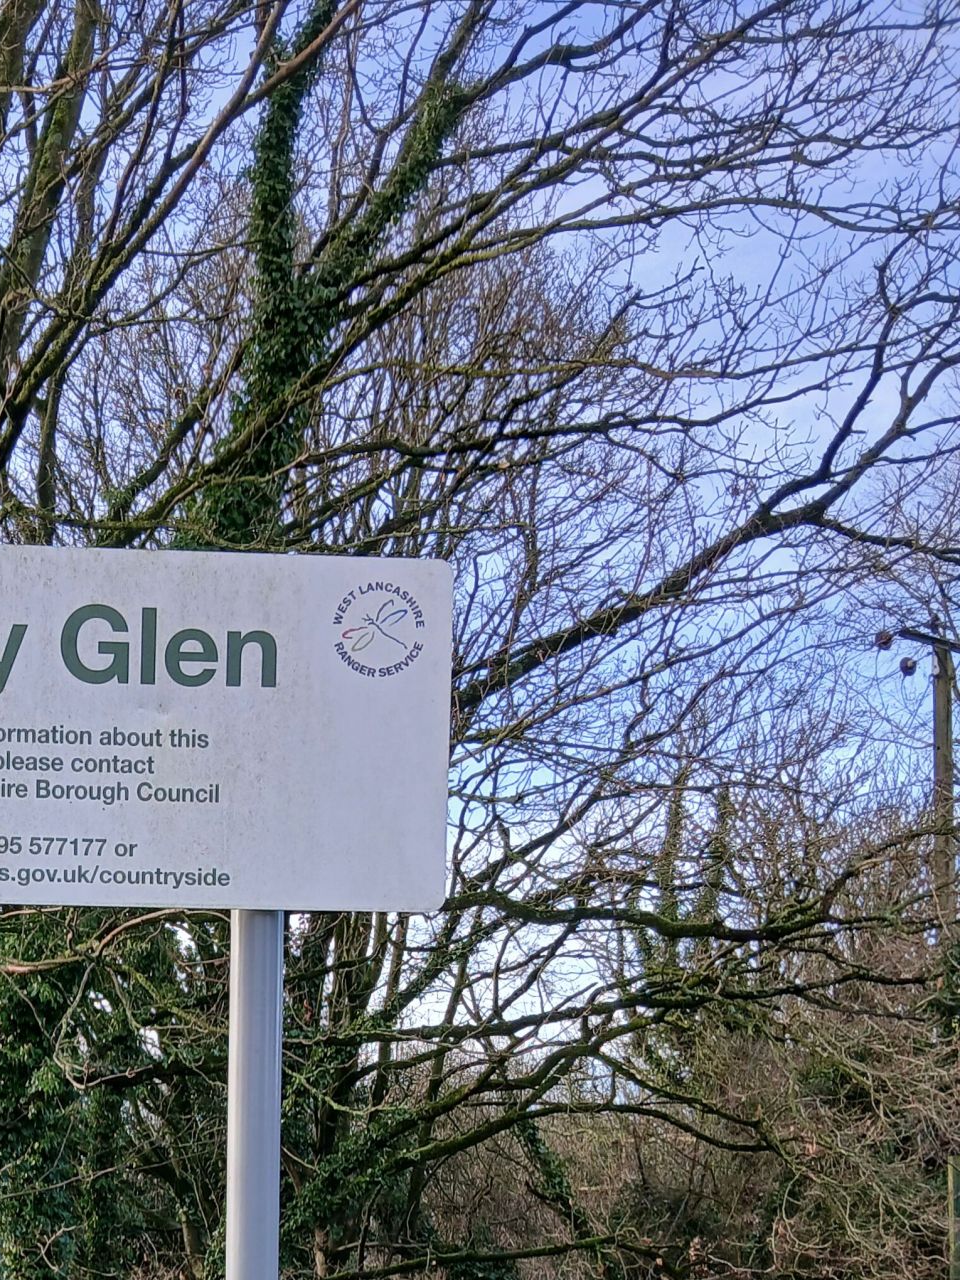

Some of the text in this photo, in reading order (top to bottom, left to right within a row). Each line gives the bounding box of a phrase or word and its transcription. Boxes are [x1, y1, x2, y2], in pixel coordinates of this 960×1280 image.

[332, 581, 425, 628] WEST LANCASHIRE
[60, 603, 278, 689] Glen
[334, 641, 424, 677] RANGER SERVICE
[99, 727, 163, 748] about
[168, 728, 210, 749] this
[70, 756, 155, 775] contact
[35, 779, 129, 806] Borough
[136, 782, 220, 804] Council
[28, 837, 107, 857] 577177
[114, 843, 138, 858] or
